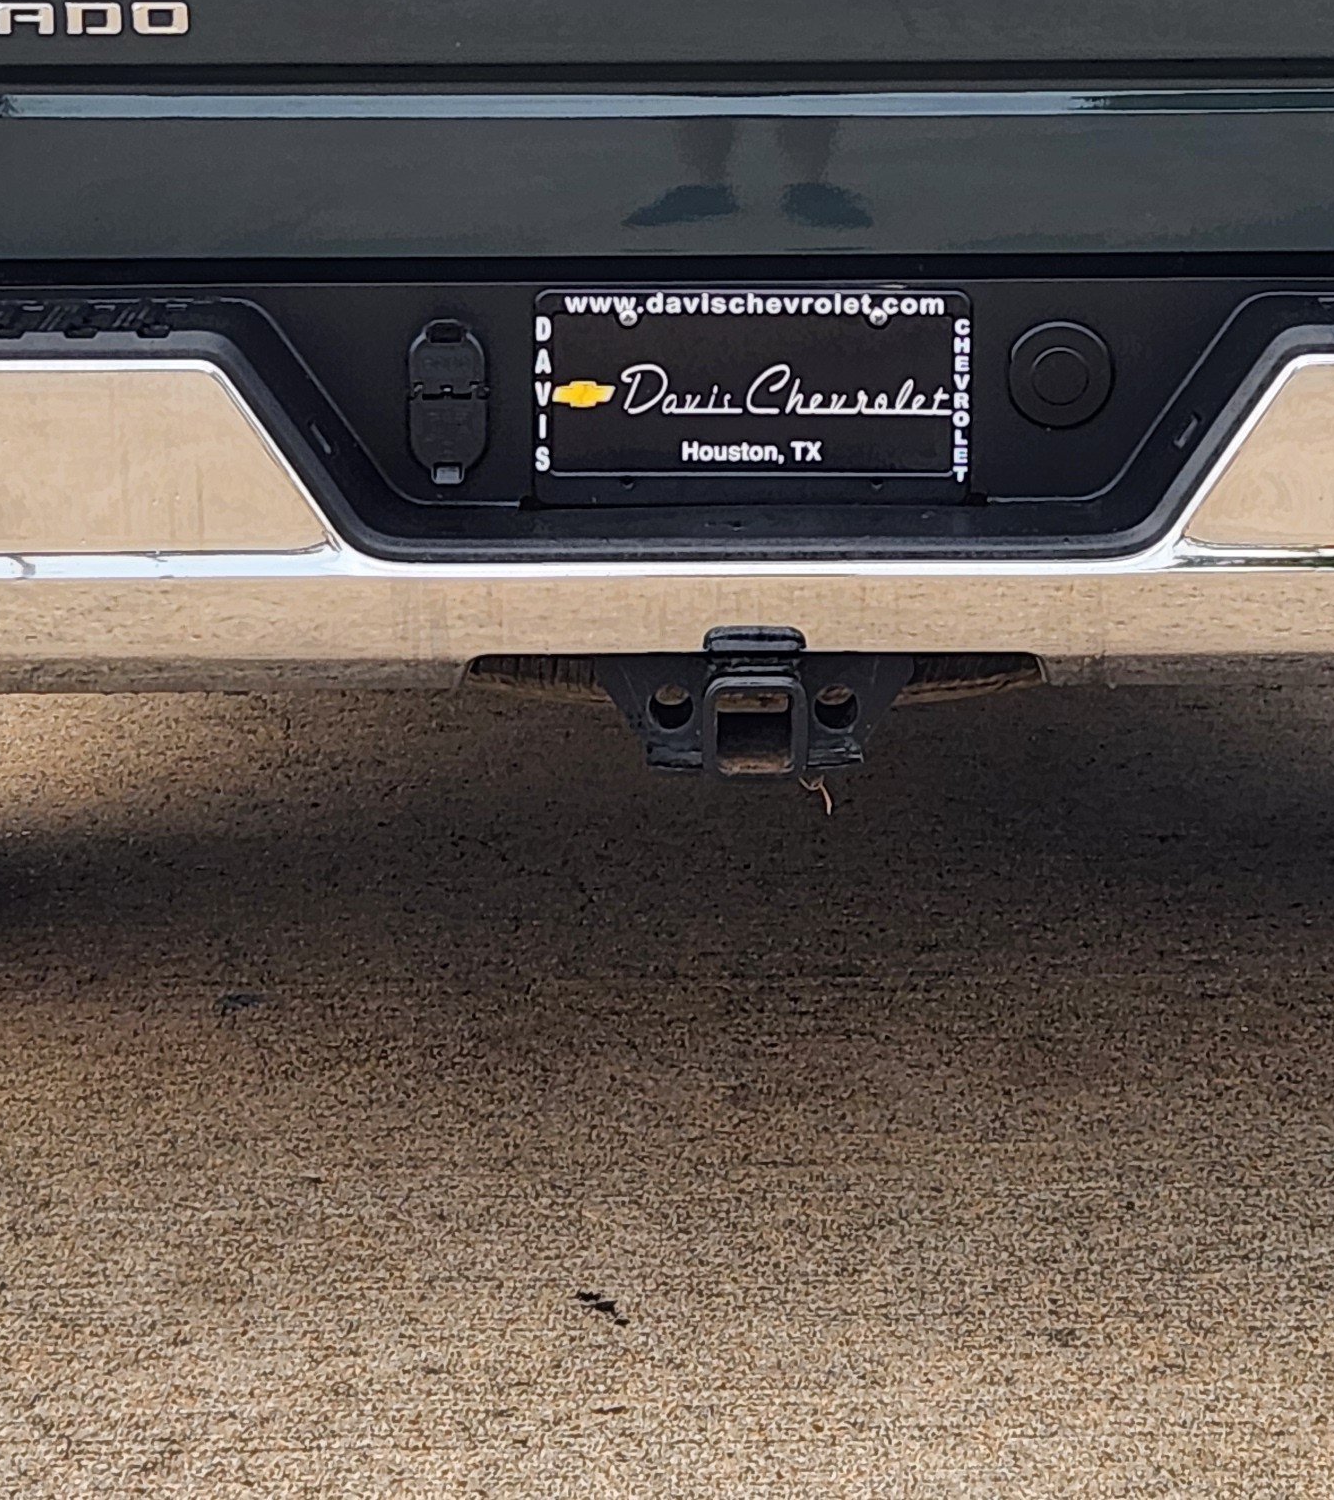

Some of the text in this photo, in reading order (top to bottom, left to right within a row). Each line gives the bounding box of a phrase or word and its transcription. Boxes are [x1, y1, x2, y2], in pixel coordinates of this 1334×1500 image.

[534, 315, 552, 472] DAVIS
[620, 362, 953, 416] Davis Chevrolet
[952, 318, 971, 483] CHEVROLET
[681, 440, 823, 465] Houston, TX
